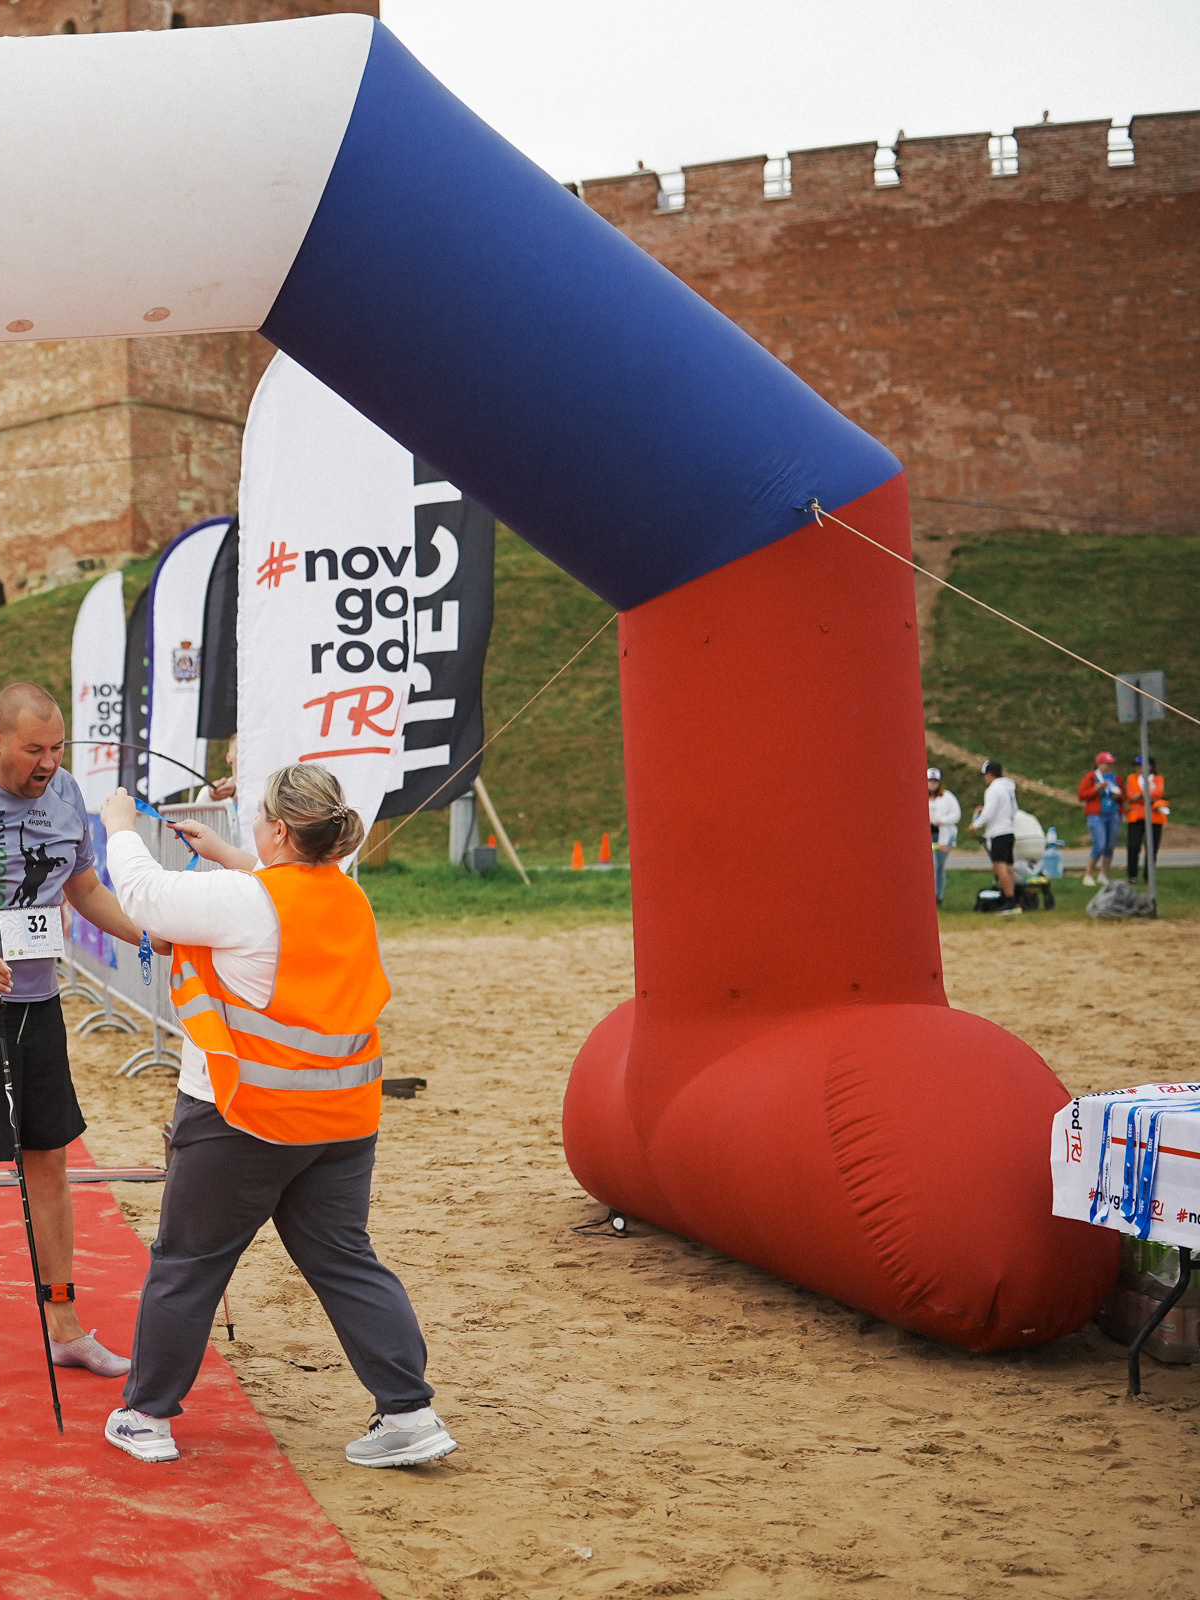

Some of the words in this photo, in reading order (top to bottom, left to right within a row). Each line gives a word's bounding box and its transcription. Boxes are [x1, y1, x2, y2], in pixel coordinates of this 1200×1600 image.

[256, 541, 412, 590] #nov
[335, 585, 409, 636] go
[311, 620, 409, 674] rod
[28, 915, 48, 932] 32
[1152, 1200, 1164, 1216] RI
